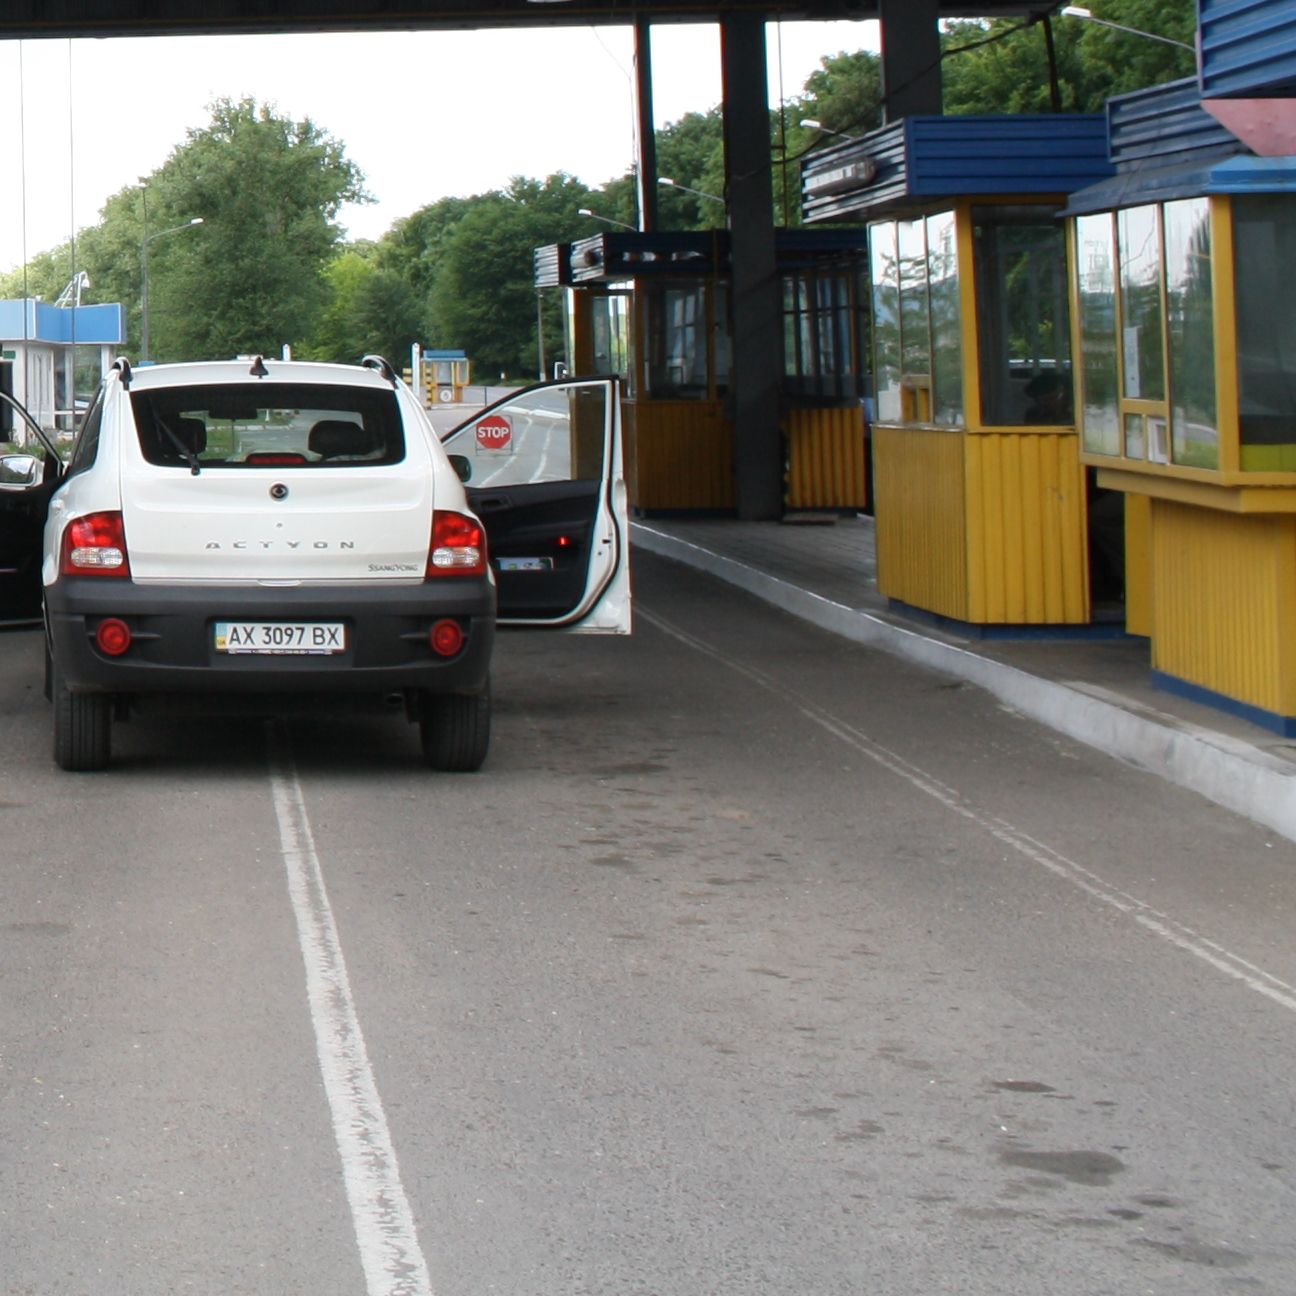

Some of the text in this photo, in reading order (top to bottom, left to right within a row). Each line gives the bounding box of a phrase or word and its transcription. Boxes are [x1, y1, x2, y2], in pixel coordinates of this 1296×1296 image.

[478, 426, 509, 439] STOP
[206, 540, 355, 549] ACTYON
[229, 626, 339, 646] AX 3097 BX
